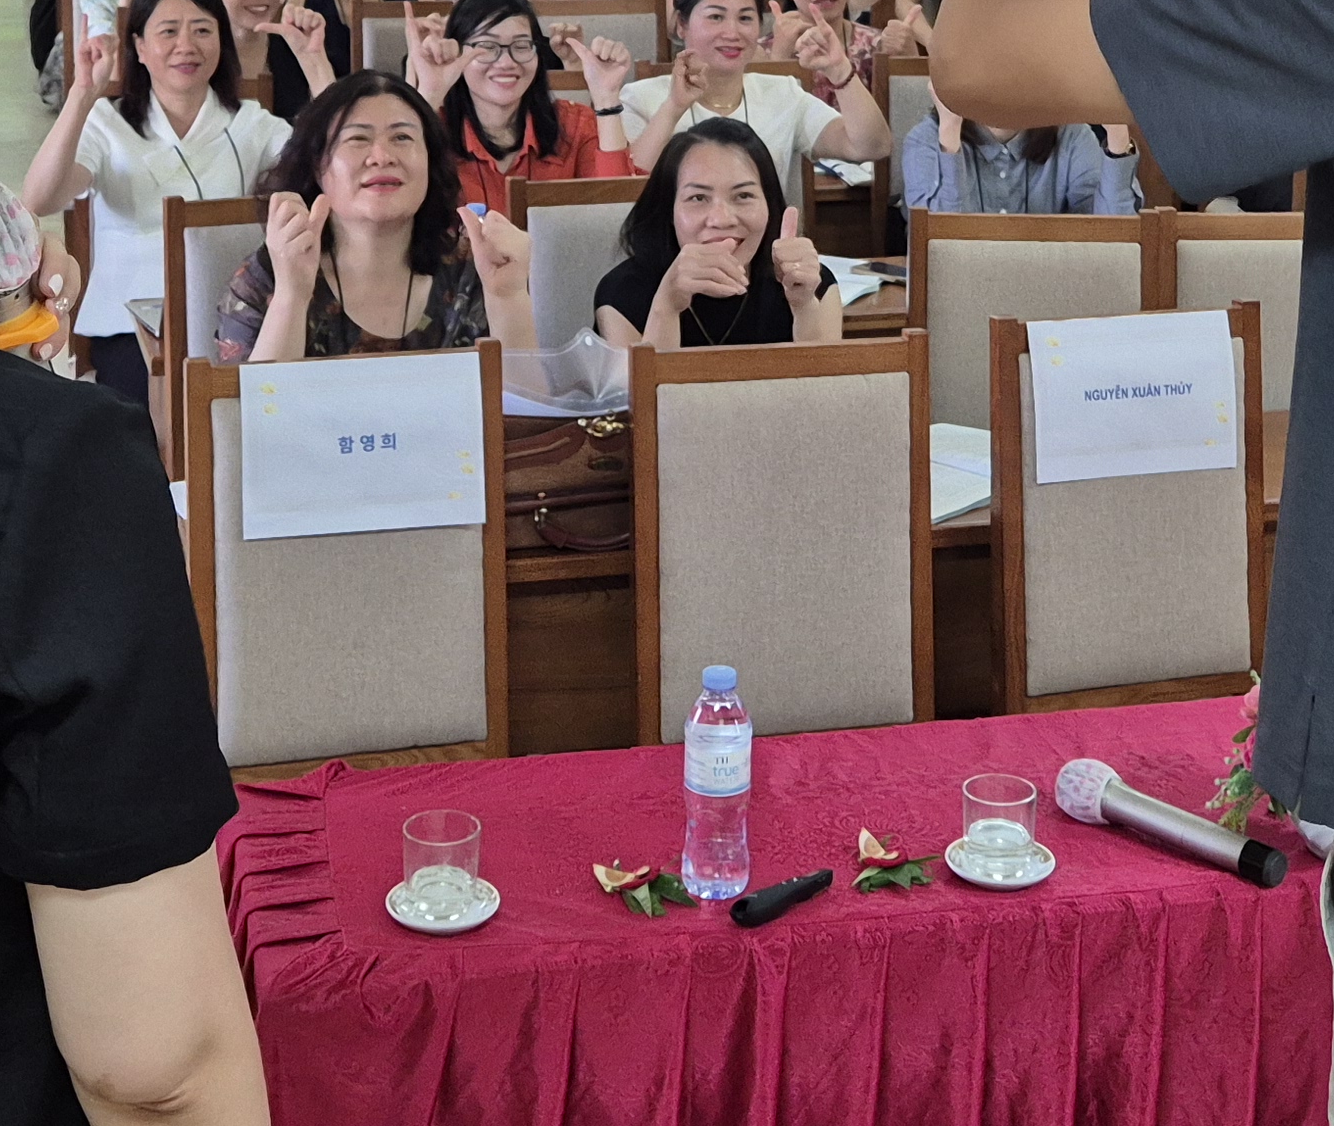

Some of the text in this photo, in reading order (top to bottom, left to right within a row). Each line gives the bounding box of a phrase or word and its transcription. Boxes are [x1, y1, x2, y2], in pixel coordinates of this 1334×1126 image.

[1083, 380, 1193, 402] NGUYỄN XUÂN THỦY
[712, 765, 740, 778] true
